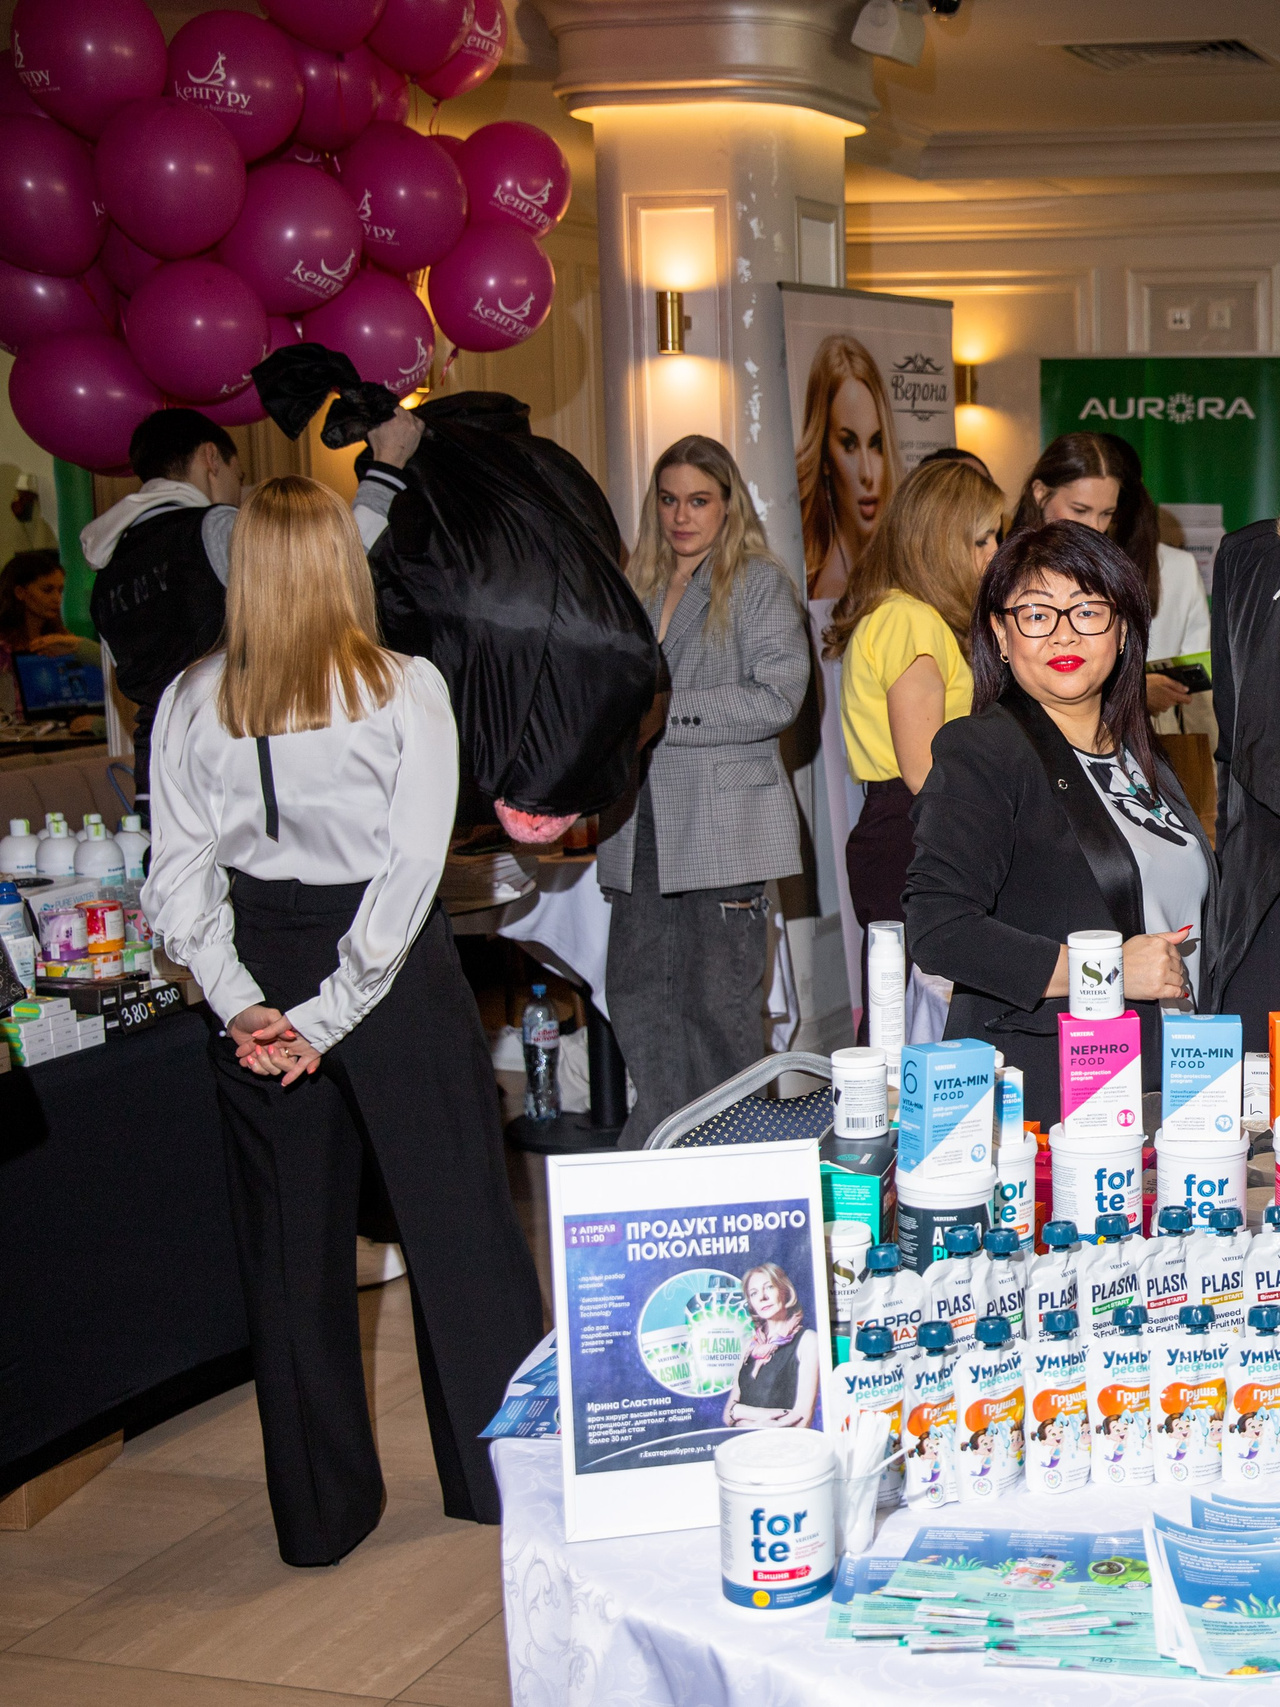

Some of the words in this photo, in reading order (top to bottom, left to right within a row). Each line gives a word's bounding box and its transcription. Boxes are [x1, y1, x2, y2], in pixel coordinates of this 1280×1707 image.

[892, 375, 947, 409] Верона
[1078, 394, 1255, 423] AURORA
[155, 988, 180, 1007] 300
[121, 1002, 148, 1026] 380
[1070, 1043, 1129, 1055] NEPHRO
[1170, 1048, 1234, 1059] VITA-MIN
[1071, 1058, 1105, 1066] FOOD
[1170, 1060, 1205, 1069] FOOD
[934, 1074, 988, 1090] VITA-MIN
[902, 1098, 923, 1110] VITA-MIN
[933, 1091, 964, 1101] FOOD
[1094, 1167, 1135, 1192] for
[1184, 1173, 1229, 1197] for
[1095, 1191, 1125, 1212] te
[571, 1227, 578, 1235] 9
[579, 1224, 616, 1235] АПРЕЛЯ
[626, 1216, 718, 1241] ПРОДУКТ
[723, 1210, 806, 1233] НОВОГО
[571, 1236, 578, 1244] В
[580, 1234, 605, 1244] 11:00
[627, 1235, 750, 1261] ПОКОЛЕНИЯ
[1111, 1299, 1130, 1309] START
[1167, 1294, 1187, 1305] START
[1223, 1291, 1243, 1301] START
[884, 1309, 922, 1326] PRO
[1155, 1323, 1175, 1333] Fruit
[1167, 1343, 1230, 1366] Умный
[969, 1351, 1022, 1384] Умный
[1051, 1391, 1087, 1410] Груша
[1180, 1388, 1218, 1404] Груша
[587, 1401, 619, 1413] Ирина
[621, 1396, 671, 1408] Сластина
[983, 1396, 1017, 1416] Груша
[605, 1413, 629, 1422] хирург
[630, 1410, 657, 1418] высшей
[668, 1414, 692, 1422] общий
[588, 1428, 627, 1437] врачебный
[589, 1436, 610, 1444] более
[750, 1507, 808, 1536] for
[751, 1537, 791, 1563] te
[757, 1571, 790, 1580] Вишня
